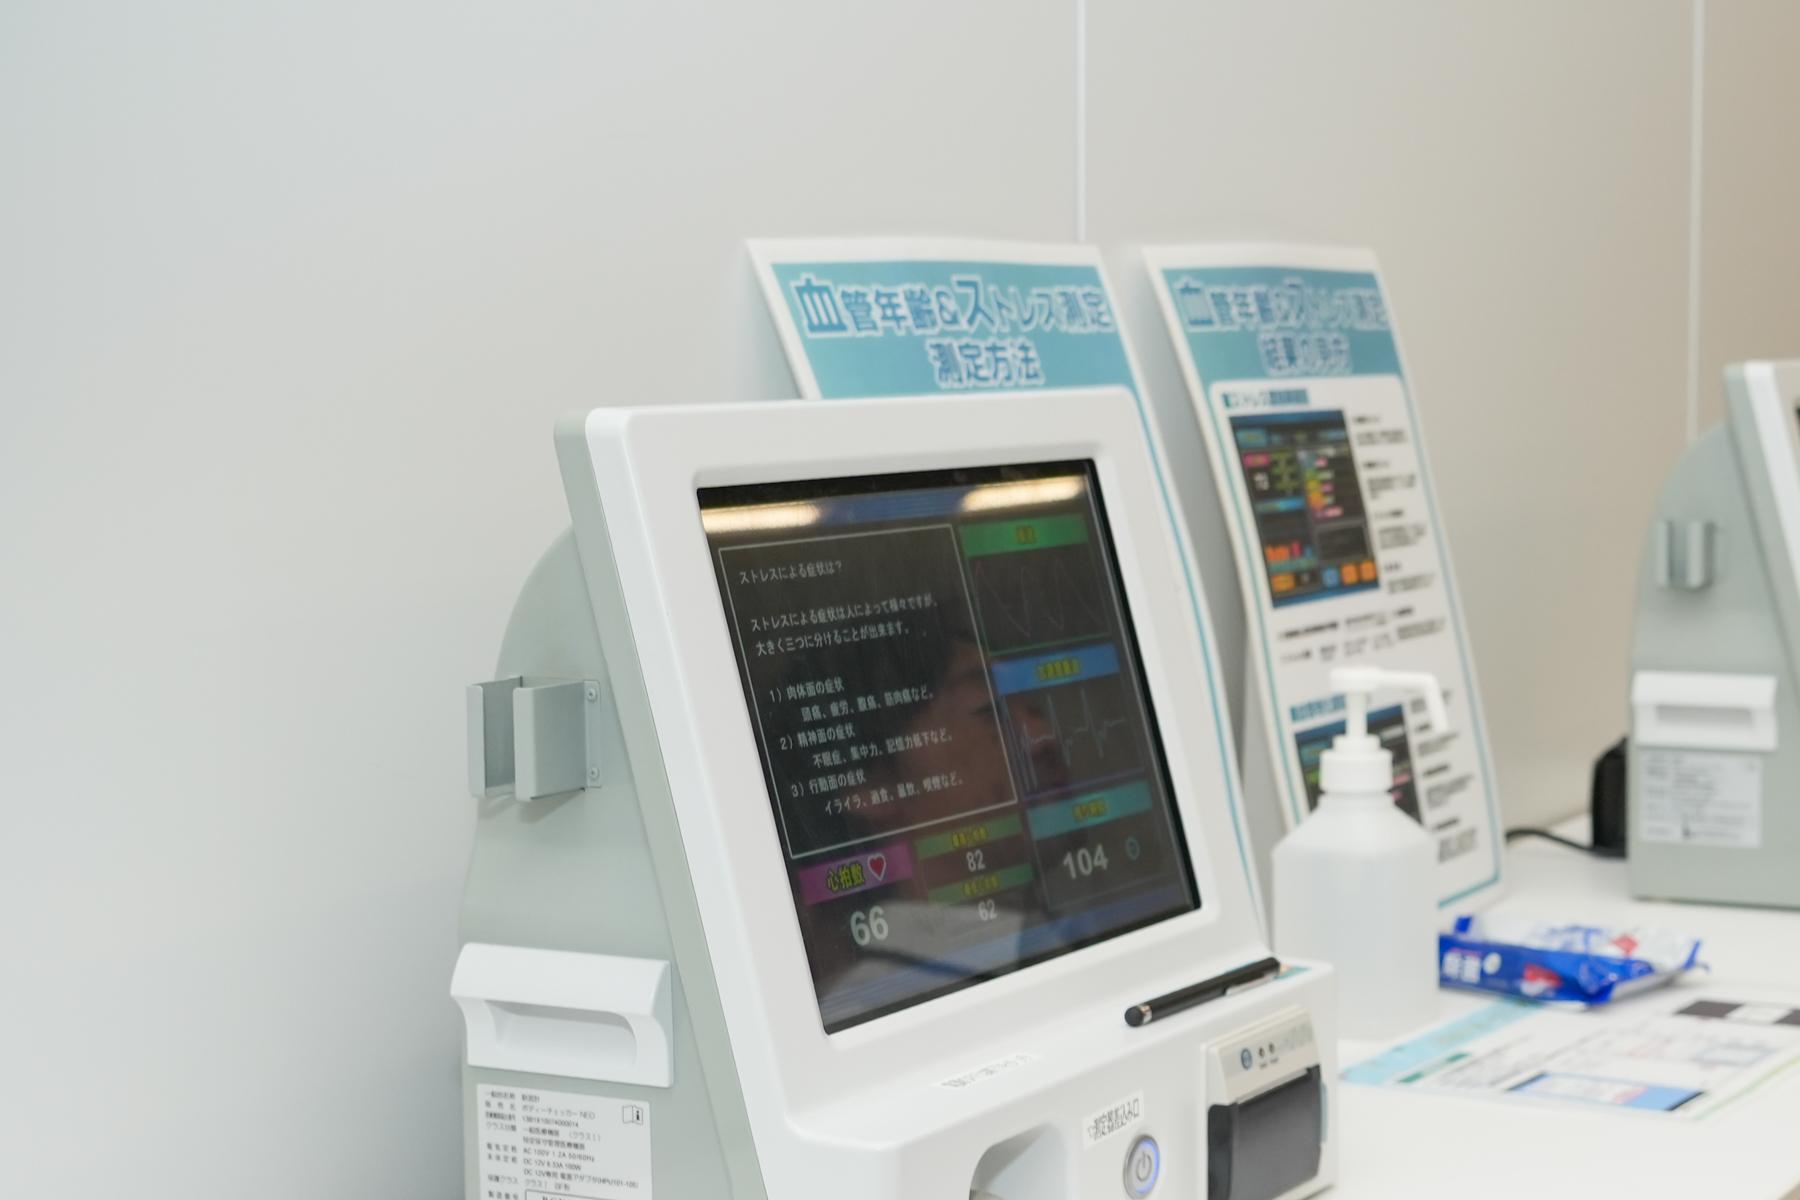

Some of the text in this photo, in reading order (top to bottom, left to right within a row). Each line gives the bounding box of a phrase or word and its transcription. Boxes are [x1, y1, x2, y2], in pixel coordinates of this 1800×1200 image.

[928, 338, 1043, 384] 測定方法
[966, 849, 986, 872] 82
[1062, 843, 1109, 879] 104
[850, 905, 889, 946] 66
[978, 898, 998, 922] 62
